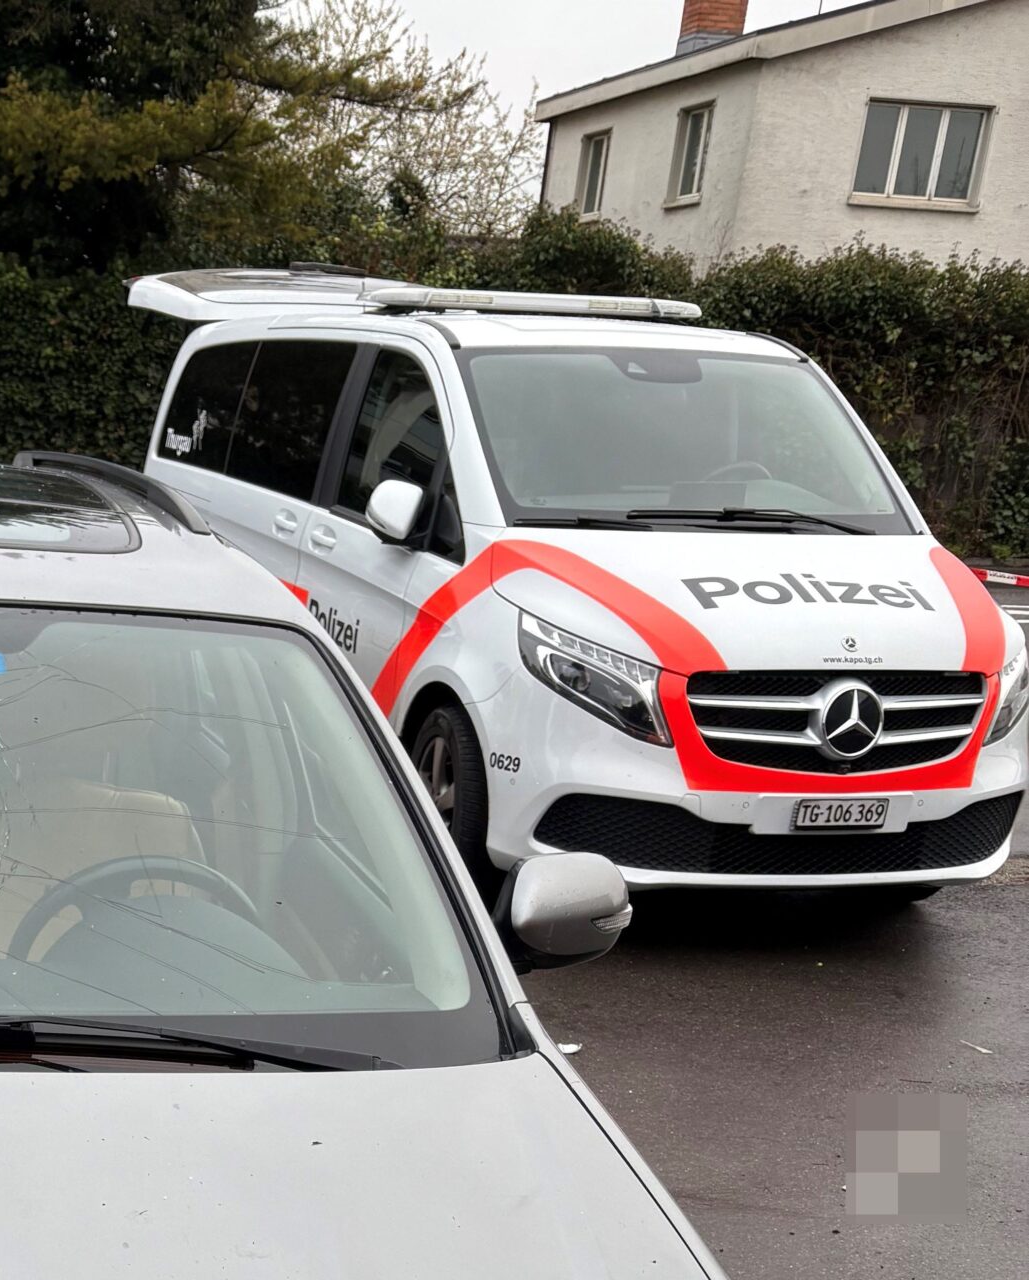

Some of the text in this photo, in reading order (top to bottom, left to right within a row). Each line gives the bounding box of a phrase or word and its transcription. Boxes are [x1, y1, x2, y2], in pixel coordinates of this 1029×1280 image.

[680, 573, 936, 612] Polizei
[822, 656, 883, 665] www.kapo.tg.ch
[489, 751, 521, 773] 0629
